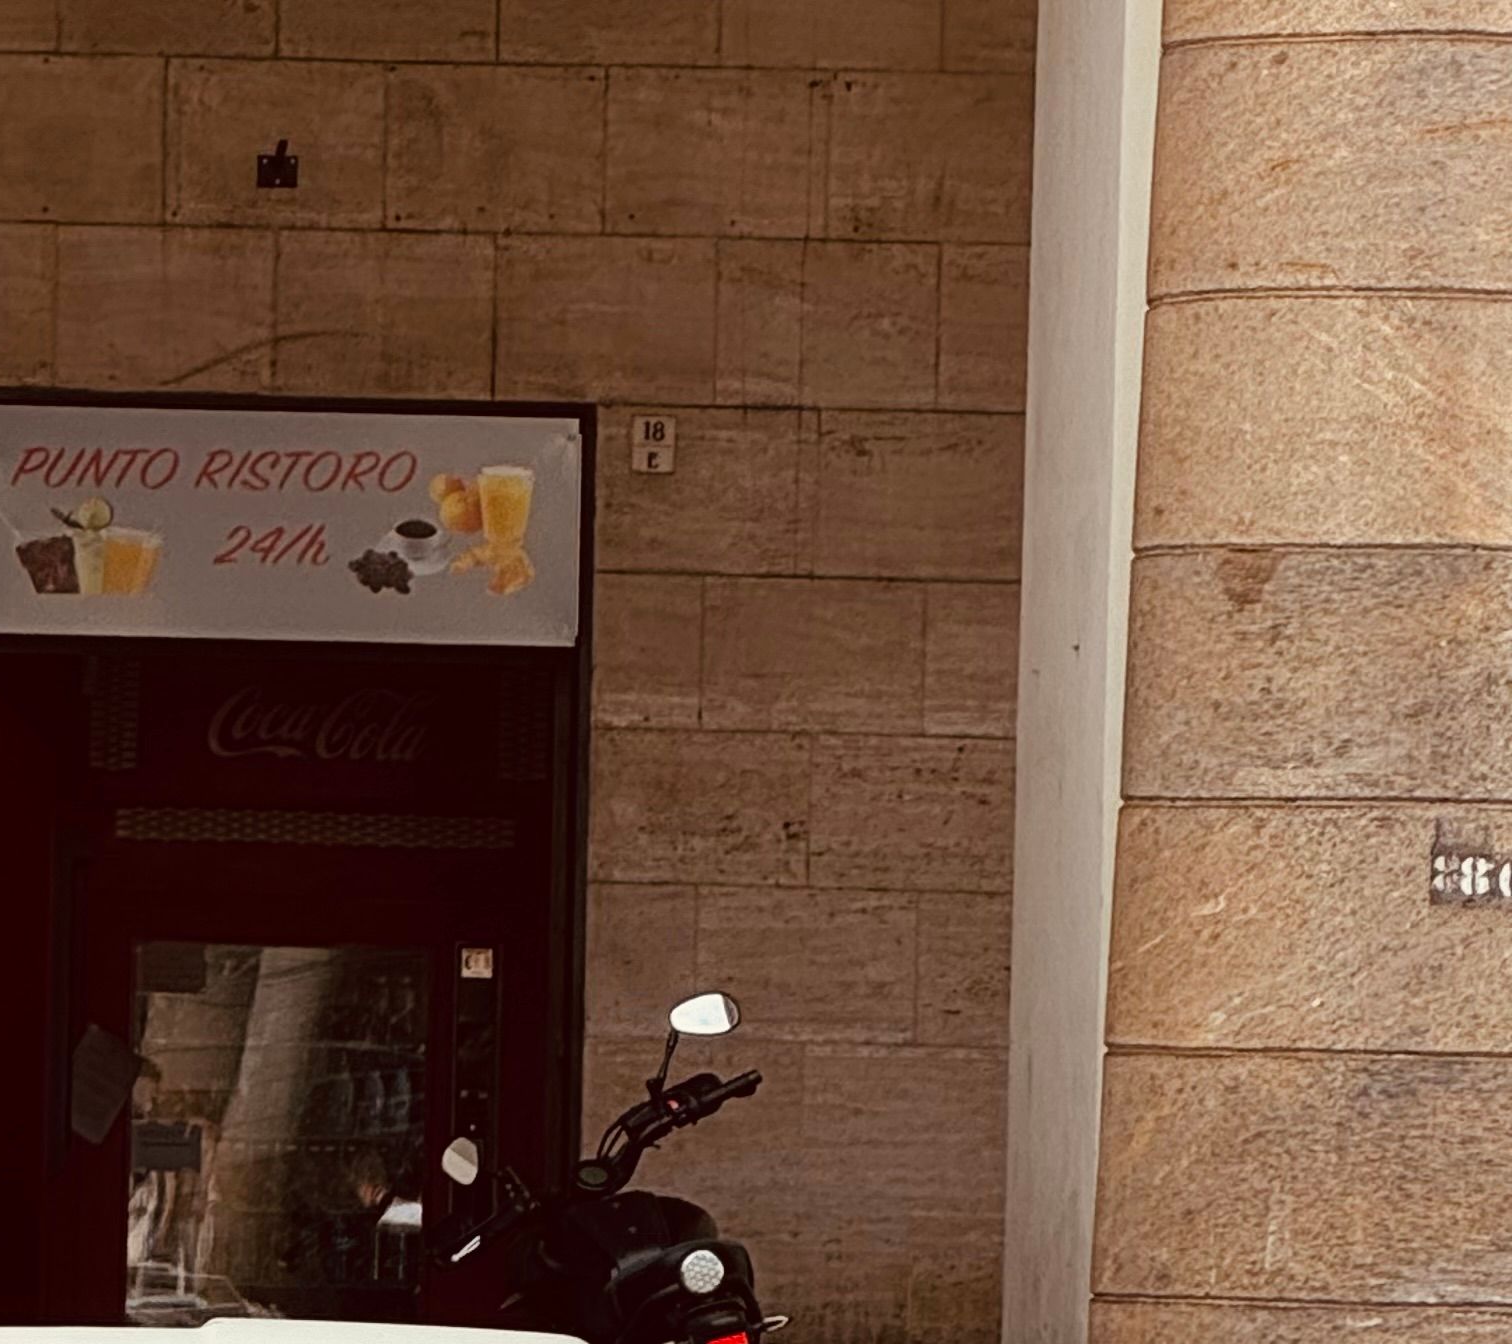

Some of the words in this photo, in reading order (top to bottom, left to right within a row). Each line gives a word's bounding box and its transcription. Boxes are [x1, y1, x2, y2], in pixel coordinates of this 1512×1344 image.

[643, 420, 666, 442] 18
[11, 446, 180, 492] PUNTO
[193, 447, 417, 494] RISTORO
[212, 523, 330, 567] 24/h
